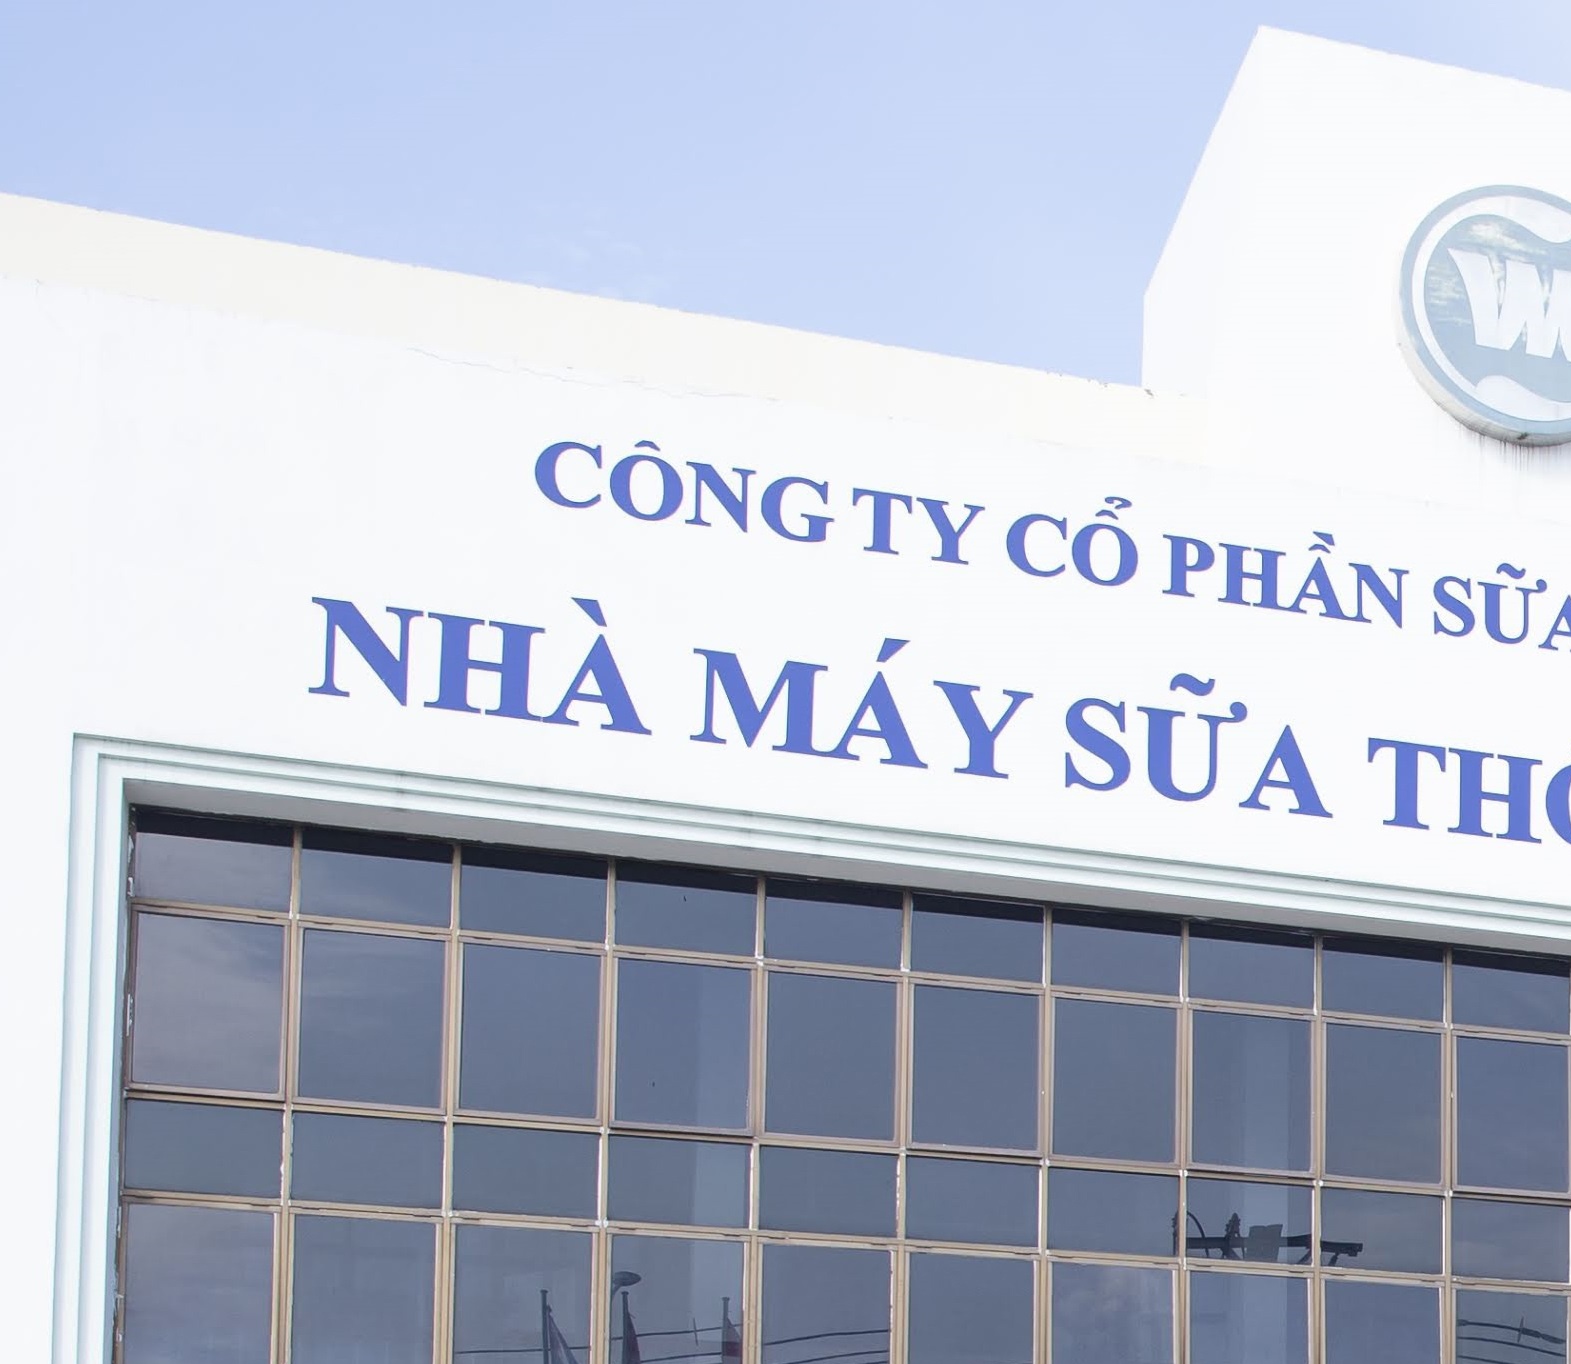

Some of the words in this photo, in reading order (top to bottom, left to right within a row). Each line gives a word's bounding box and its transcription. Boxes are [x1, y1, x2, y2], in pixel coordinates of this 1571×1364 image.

[534, 439, 835, 544] CÔNG
[852, 486, 986, 565] TY
[1005, 495, 1140, 587] CỔ
[1162, 530, 1409, 629] PHẦN
[308, 595, 653, 737] NHÀ
[689, 637, 1034, 782] MÁY
[1064, 672, 1333, 820] SỮA
